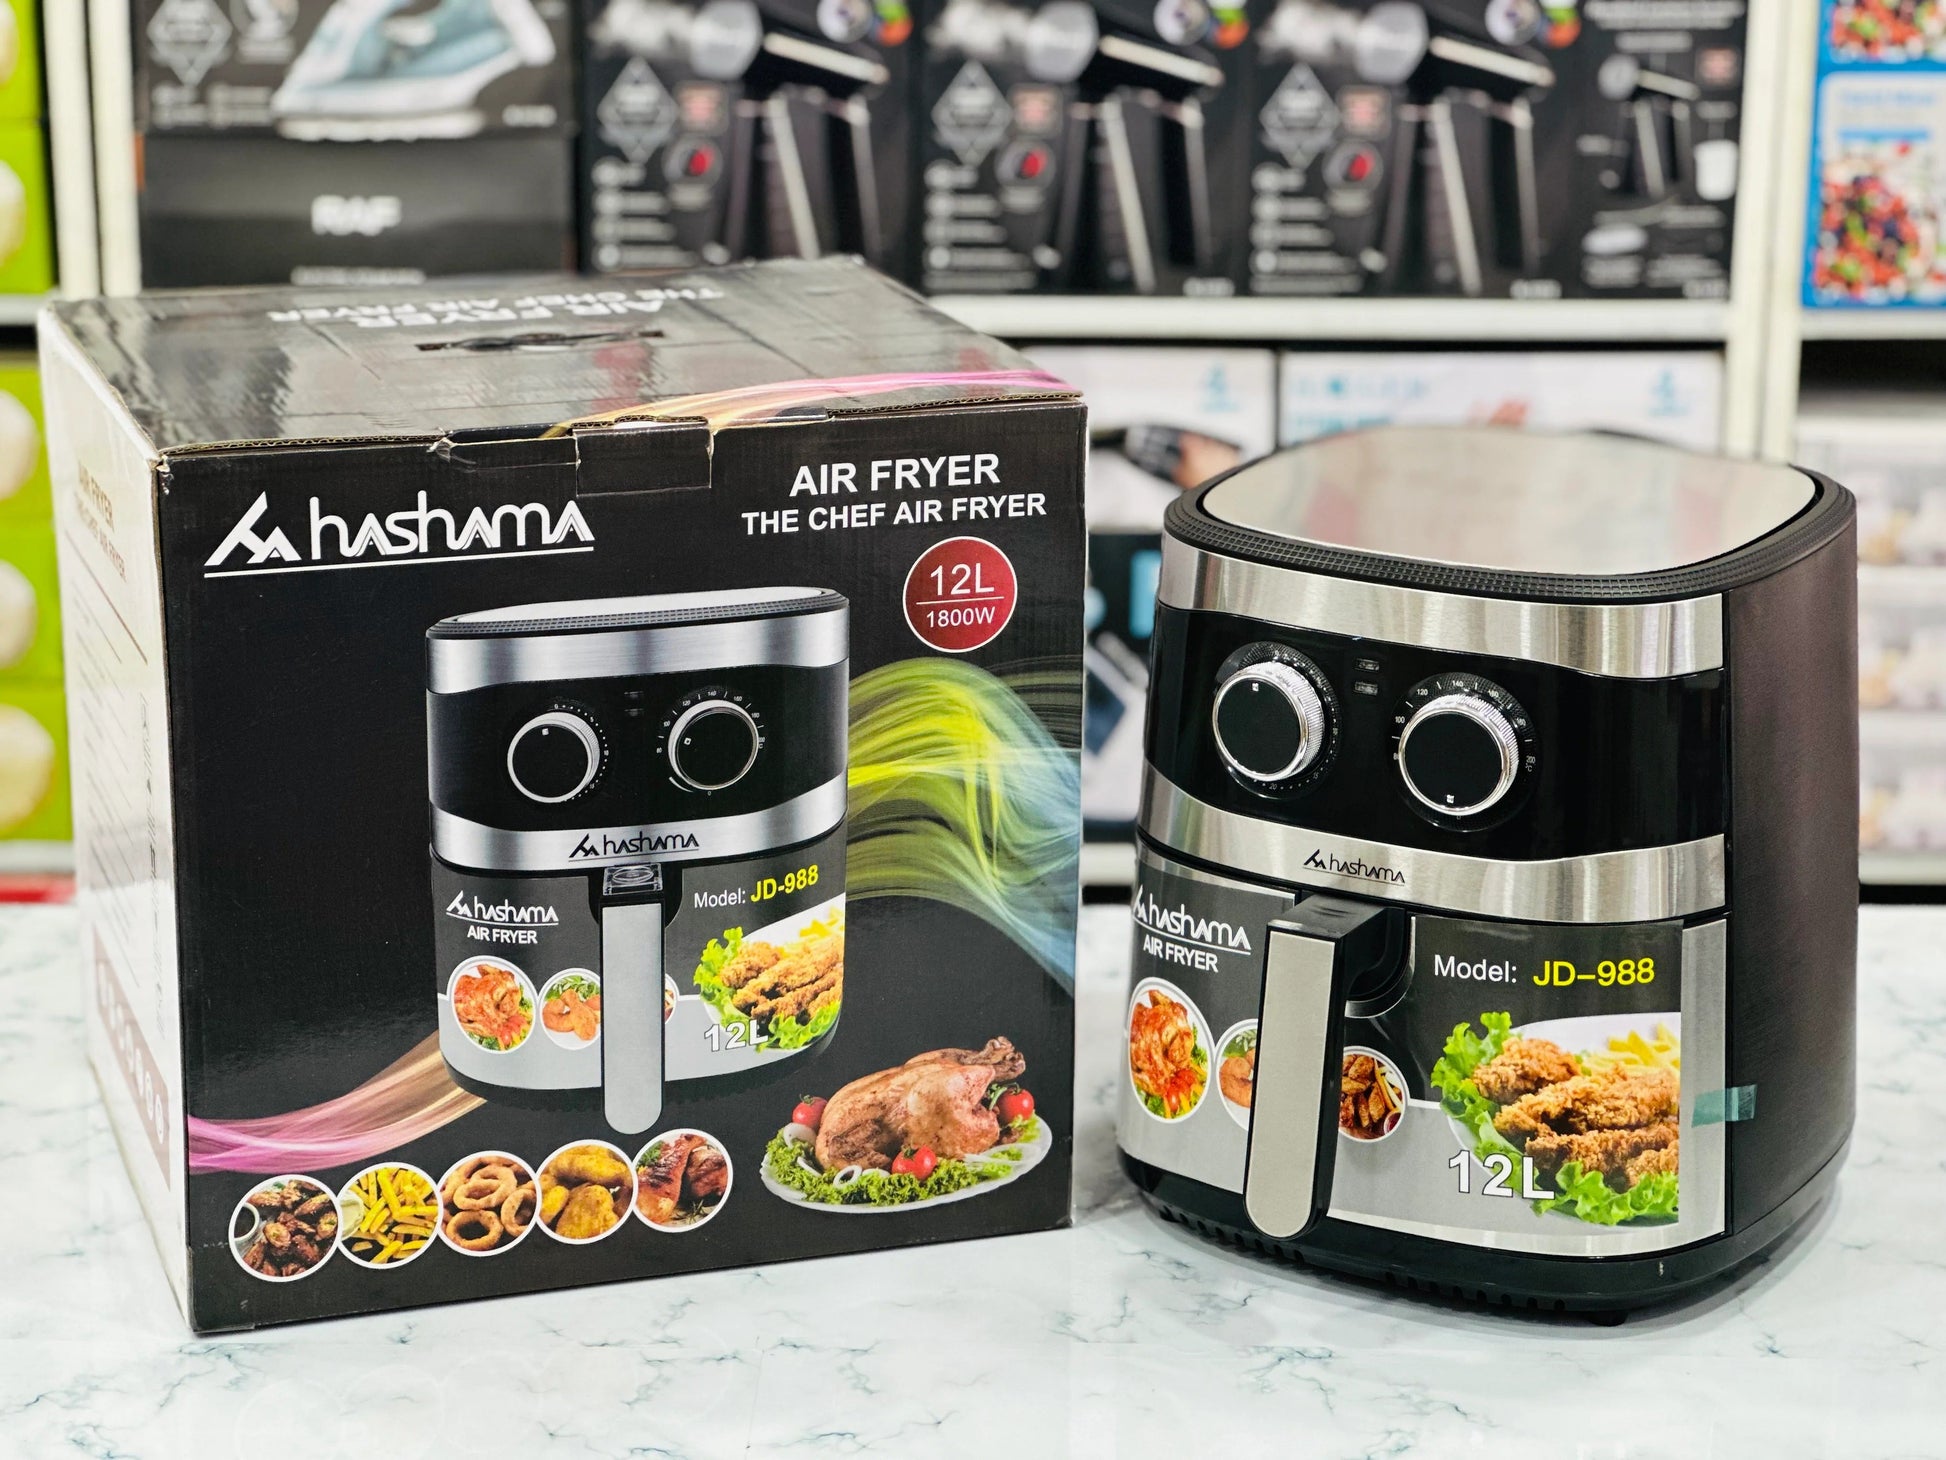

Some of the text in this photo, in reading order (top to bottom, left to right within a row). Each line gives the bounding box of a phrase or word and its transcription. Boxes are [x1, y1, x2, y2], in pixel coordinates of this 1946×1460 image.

[789, 453, 1000, 497] AIR FRYER
[309, 490, 595, 560] hashama
[741, 492, 1047, 535] THE CHEF AIR FRYER
[930, 562, 995, 597] 12L
[926, 606, 996, 628] 1800W
[1416, 688, 1429, 696] 120
[1394, 716, 1406, 724] 100
[602, 830, 699, 856] hashama
[1329, 853, 1406, 884] hashama
[694, 864, 819, 909] Model: JD-988
[474, 898, 559, 924] hashama
[1148, 893, 1251, 951] hashama
[467, 925, 538, 945] AIR FRYER
[1143, 934, 1219, 973] AIR FRYER
[1434, 954, 1517, 984] Model:
[704, 1019, 769, 1053] 12L
[1448, 1149, 1555, 1200] 12L
